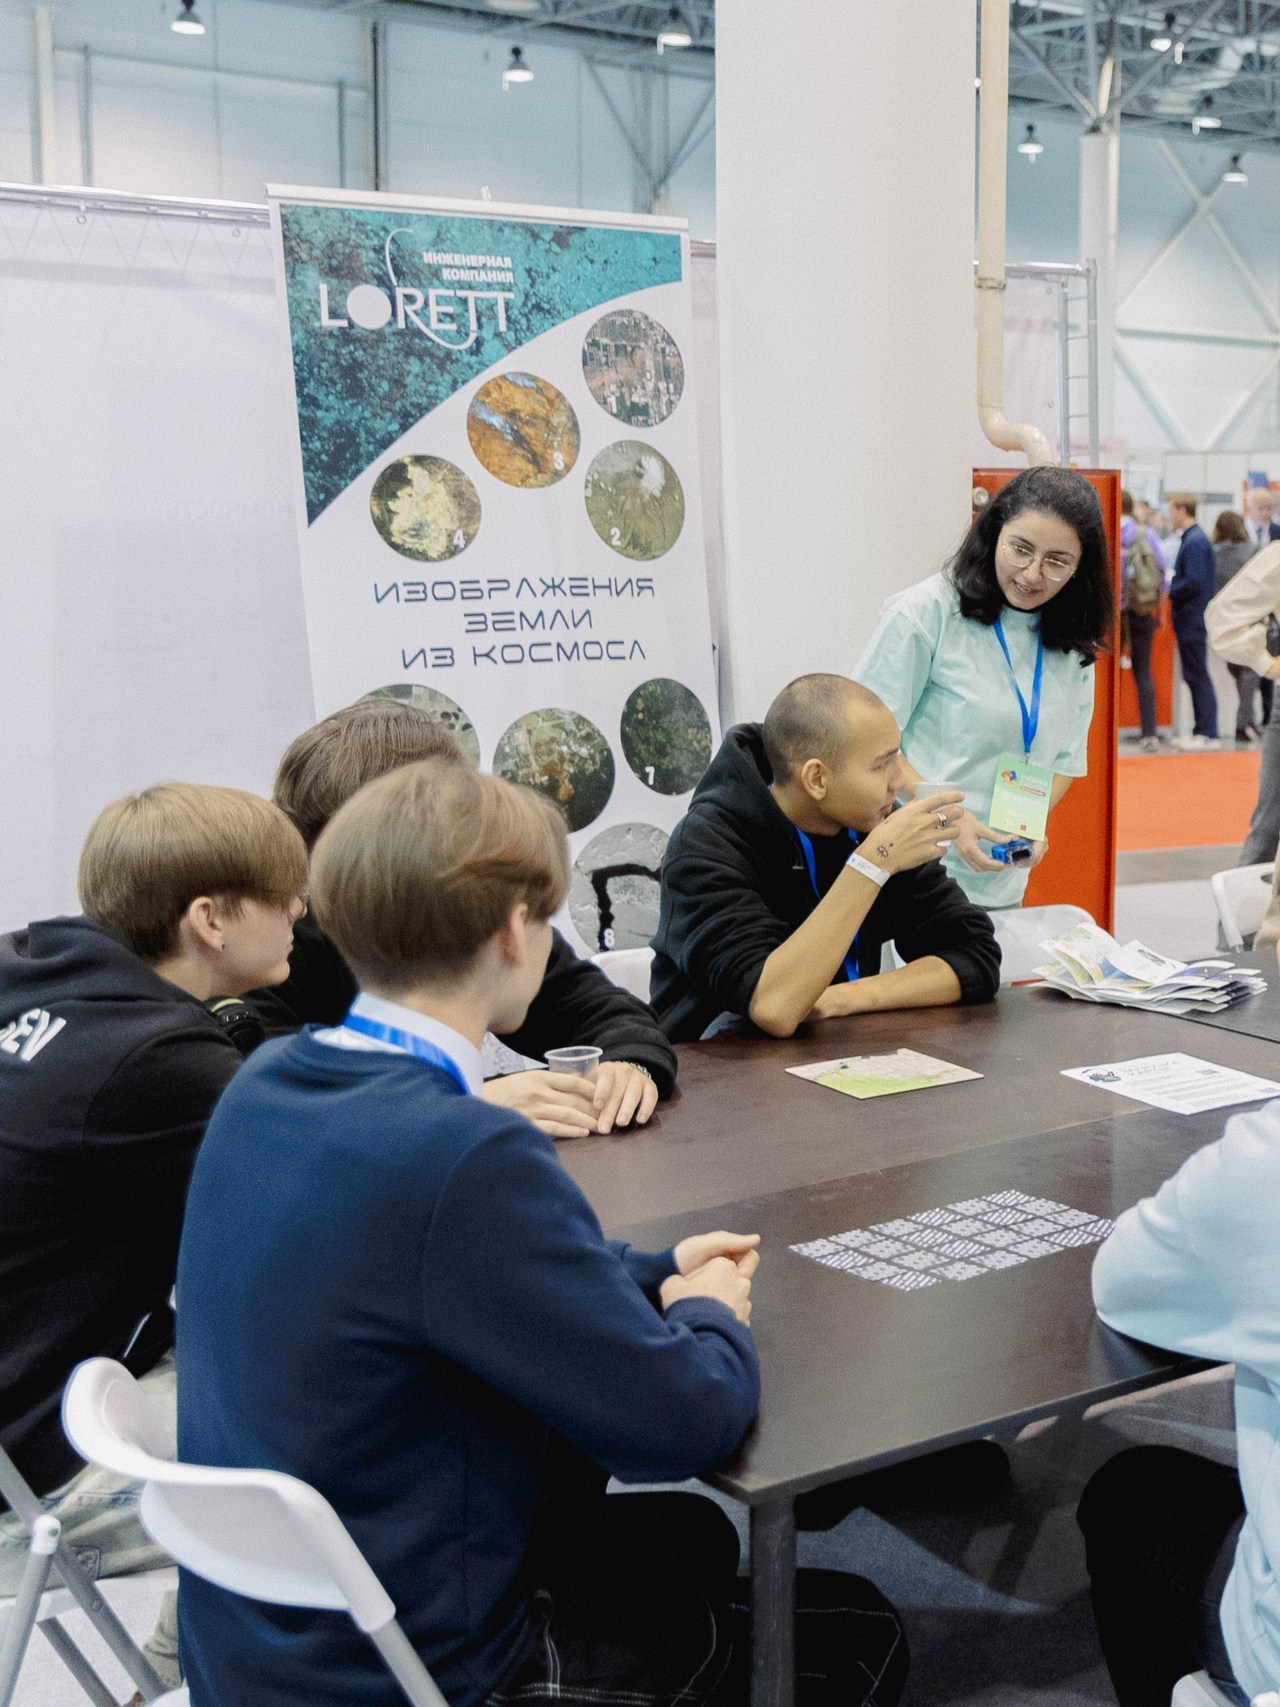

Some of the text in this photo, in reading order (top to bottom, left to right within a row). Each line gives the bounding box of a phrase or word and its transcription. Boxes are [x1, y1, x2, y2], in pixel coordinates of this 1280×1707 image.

[422, 251, 513, 268] ИНЖЕНЕРНАЯ
[442, 267, 514, 284] КОМПАНИЯ
[319, 283, 515, 350] LORETT
[553, 451, 565, 471] 3
[453, 528, 466, 548] 4
[610, 527, 621, 546] 2
[373, 576, 656, 604] ИЗОБРАЖЕНИЯ
[463, 608, 593, 633] ЗЕМЛИ
[401, 639, 647, 669] ИЗ КОСМОСА
[645, 766, 655, 785] 7
[603, 928, 615, 948] 8
